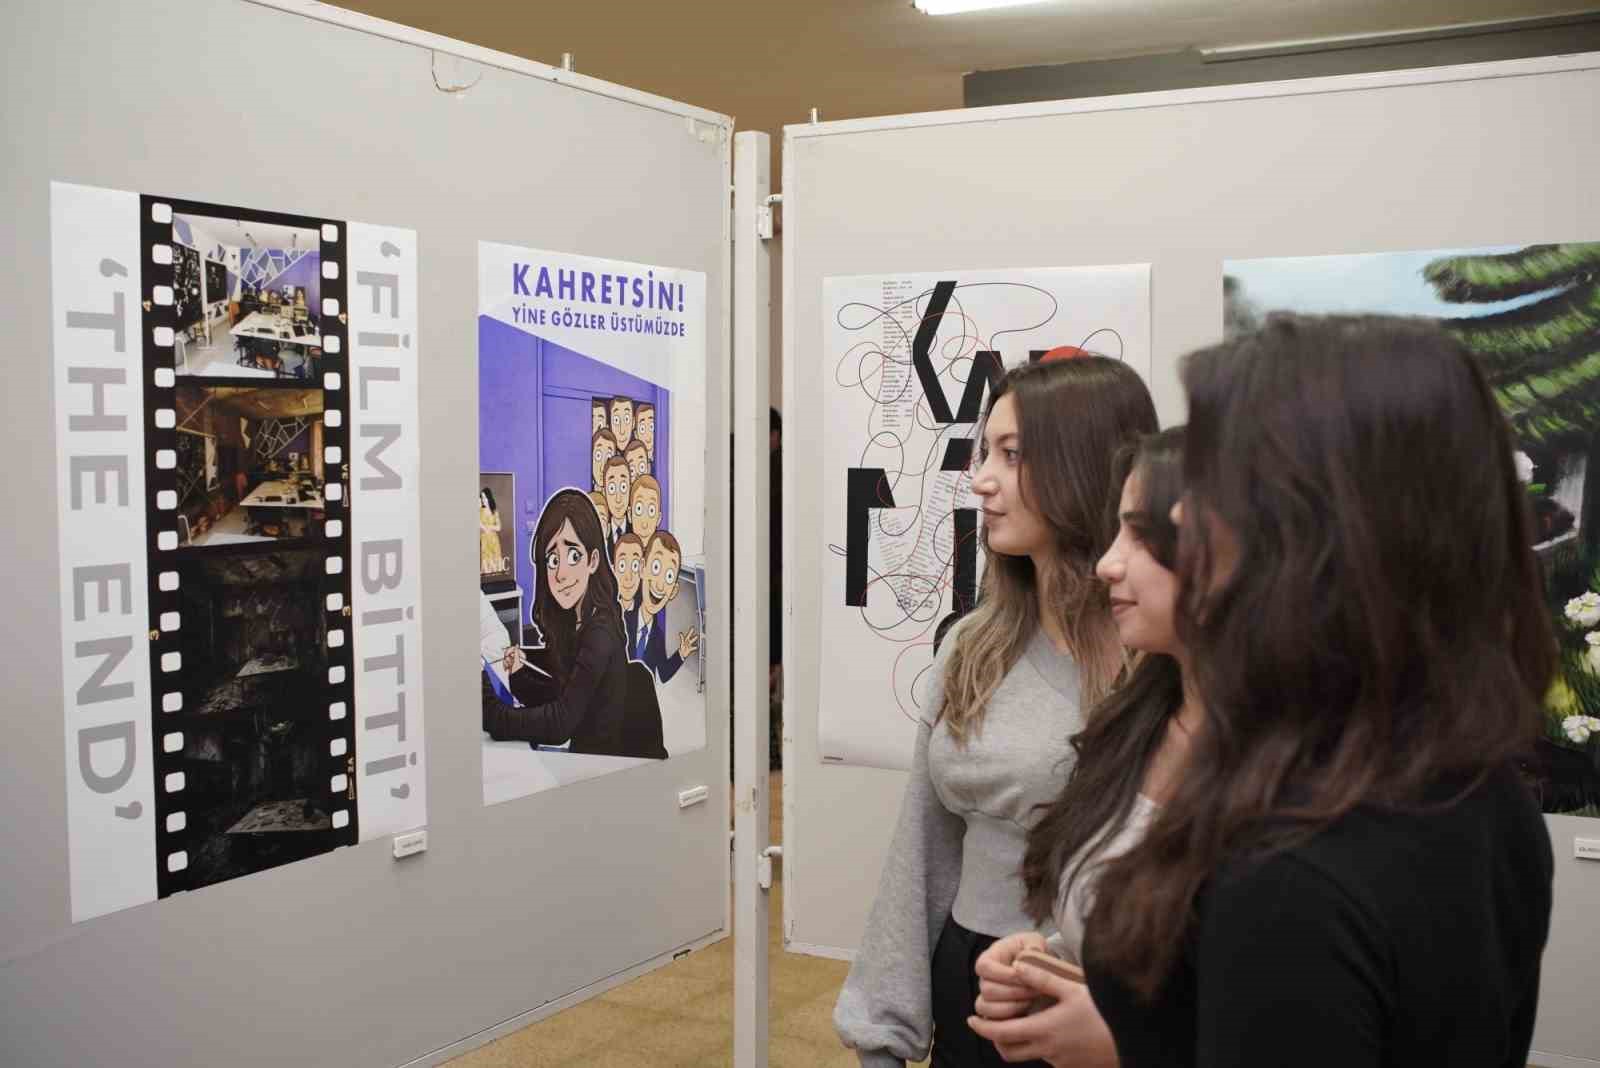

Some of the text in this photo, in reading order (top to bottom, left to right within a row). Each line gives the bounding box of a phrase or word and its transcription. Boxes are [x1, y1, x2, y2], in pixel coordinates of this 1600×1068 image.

[512, 263, 685, 313] KAHRETSİN!
[512, 303, 686, 337] YİNE GÖZLER ÜSTÜMÜZDE
